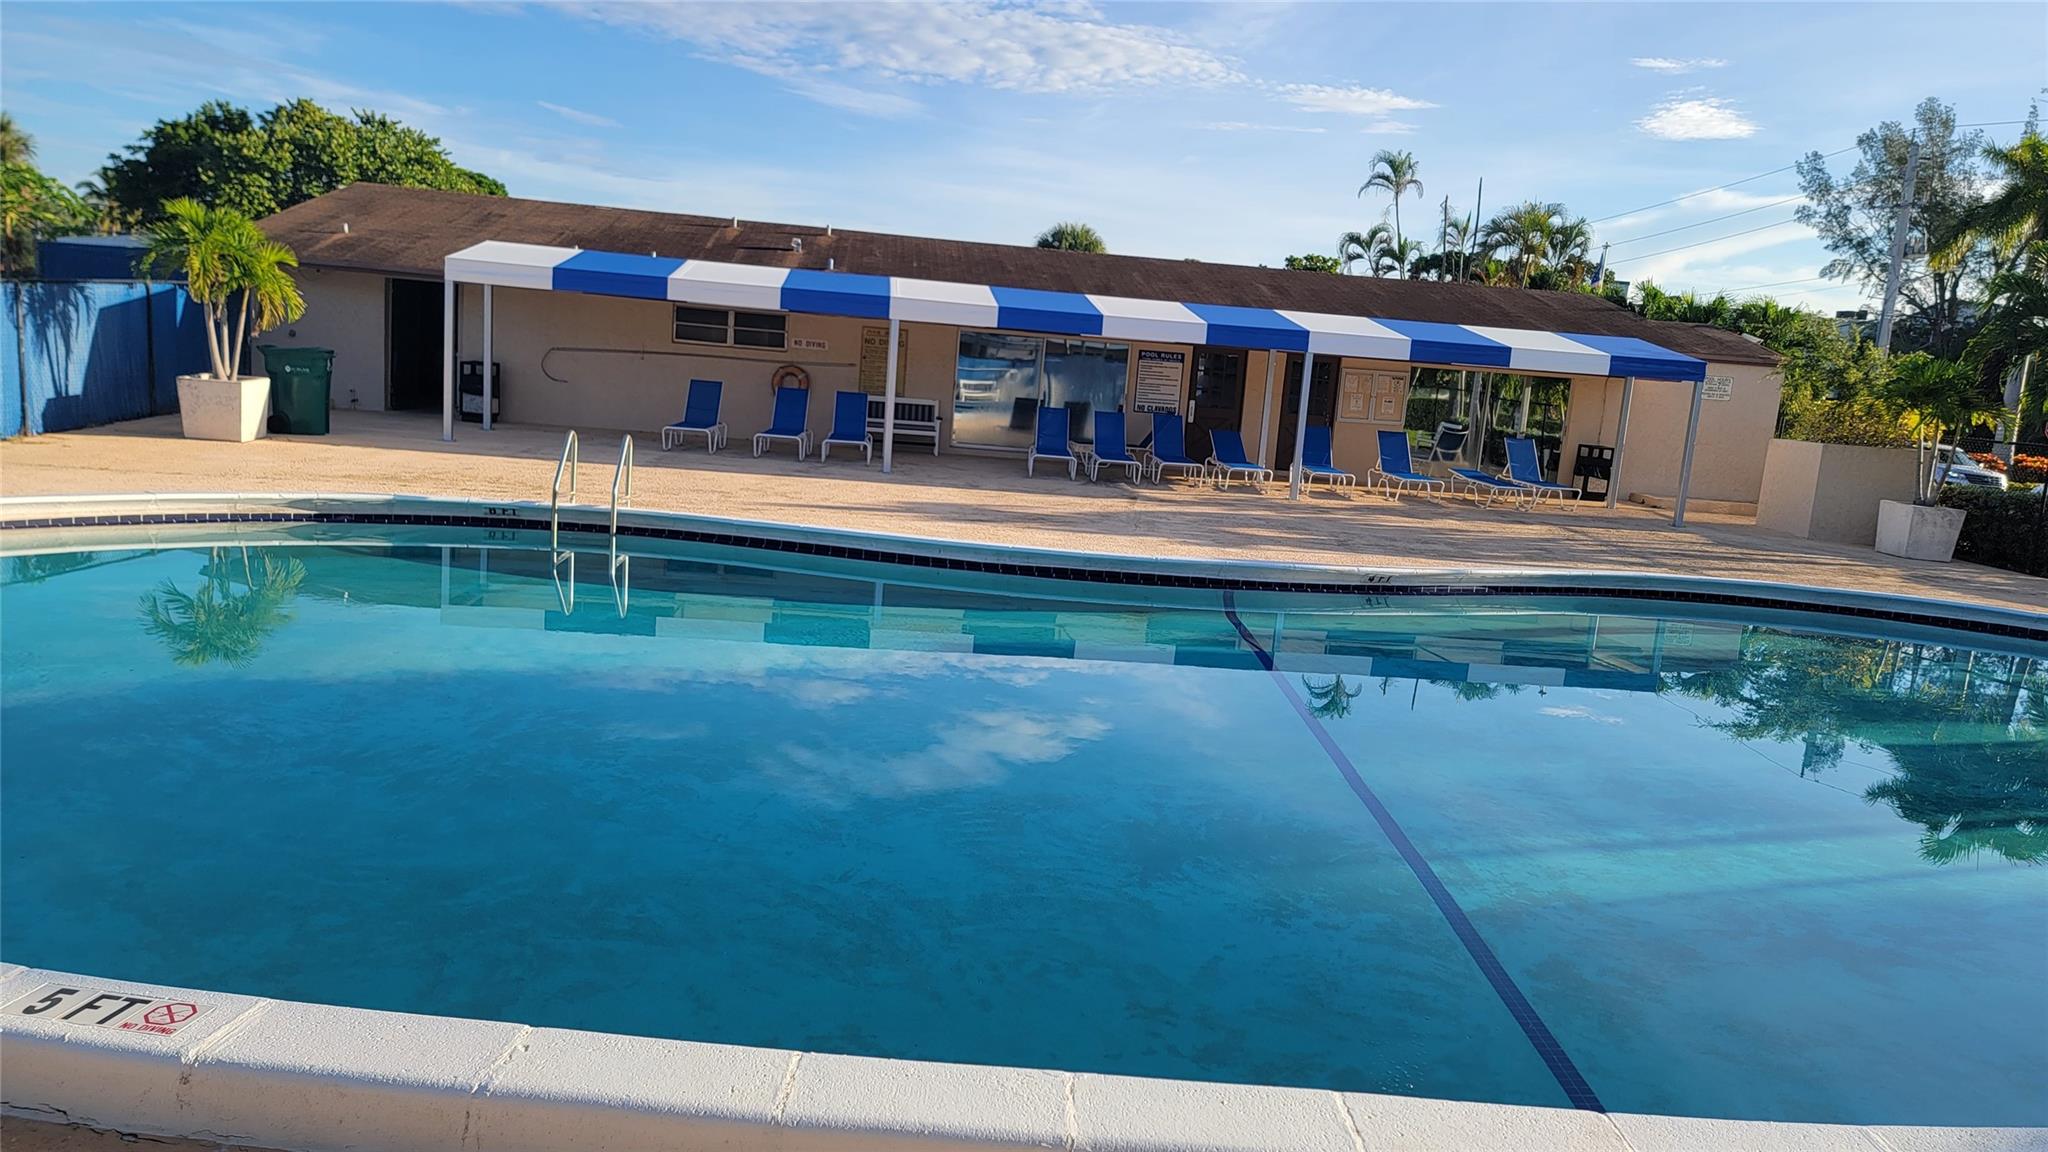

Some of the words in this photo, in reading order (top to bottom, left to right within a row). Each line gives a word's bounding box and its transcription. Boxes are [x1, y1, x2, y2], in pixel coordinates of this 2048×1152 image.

[806, 341, 826, 349] DIVING
[864, 337, 876, 345] NO
[22, 988, 80, 1015] 5
[61, 993, 154, 1025] FT
[119, 1022, 138, 1030] NO
[140, 1024, 178, 1036] DIVING
